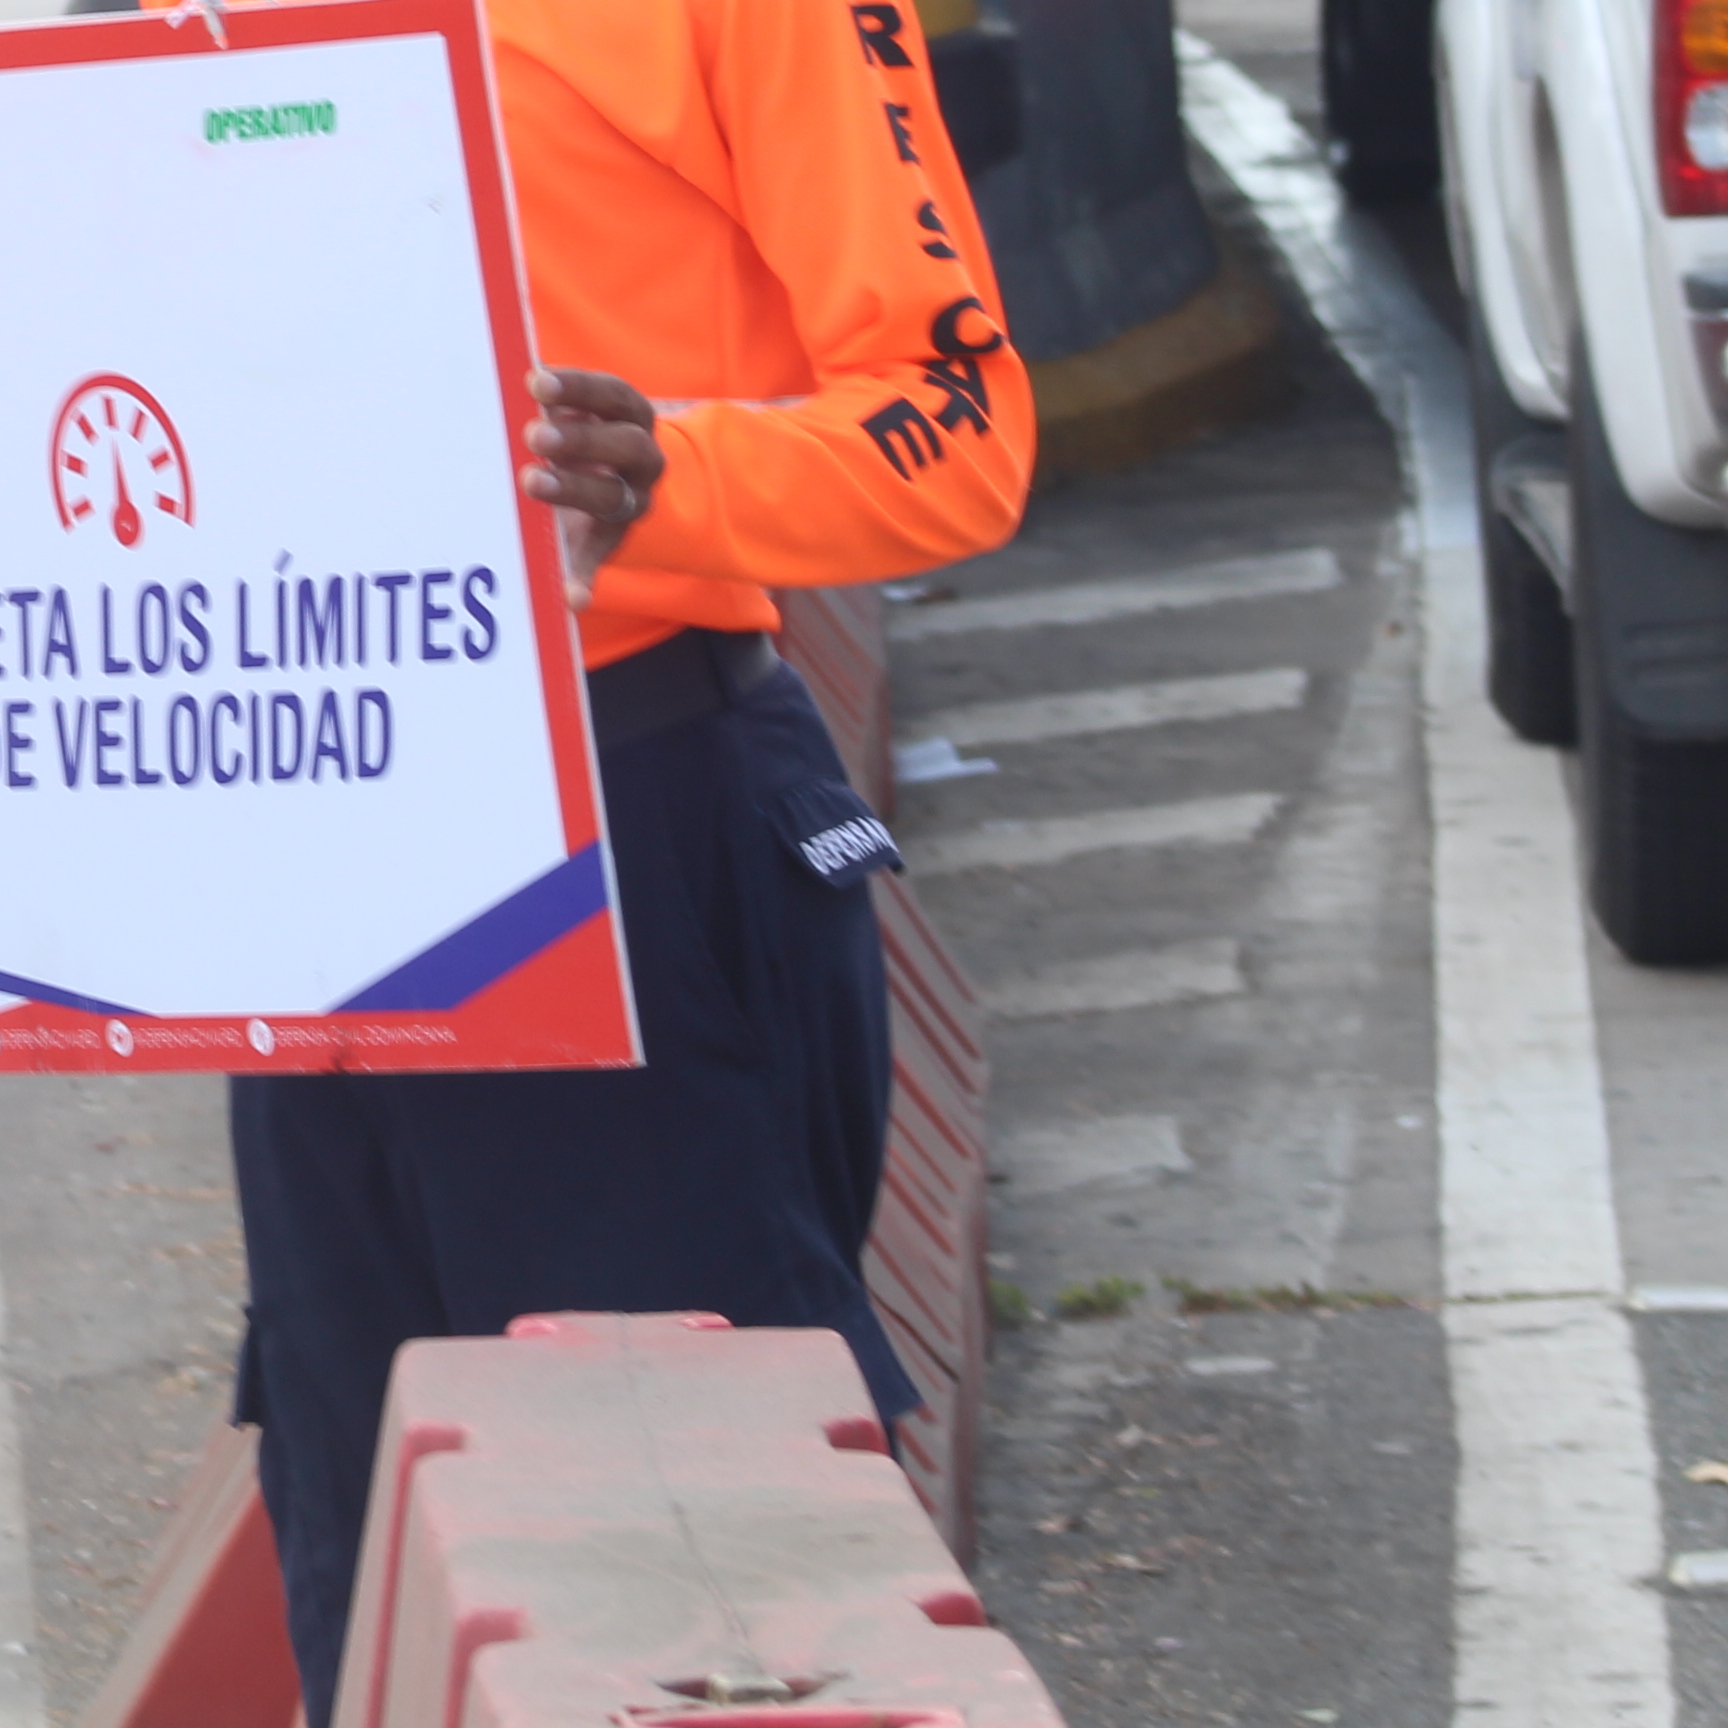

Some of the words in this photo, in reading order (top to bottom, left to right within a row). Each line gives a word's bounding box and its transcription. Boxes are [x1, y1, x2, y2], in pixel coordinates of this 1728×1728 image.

[203, 99, 337, 145] OPERATIVO
[99, 576, 214, 677] LOS
[233, 548, 501, 671] LÍMITES
[54, 685, 396, 791] VELOCIDAD
